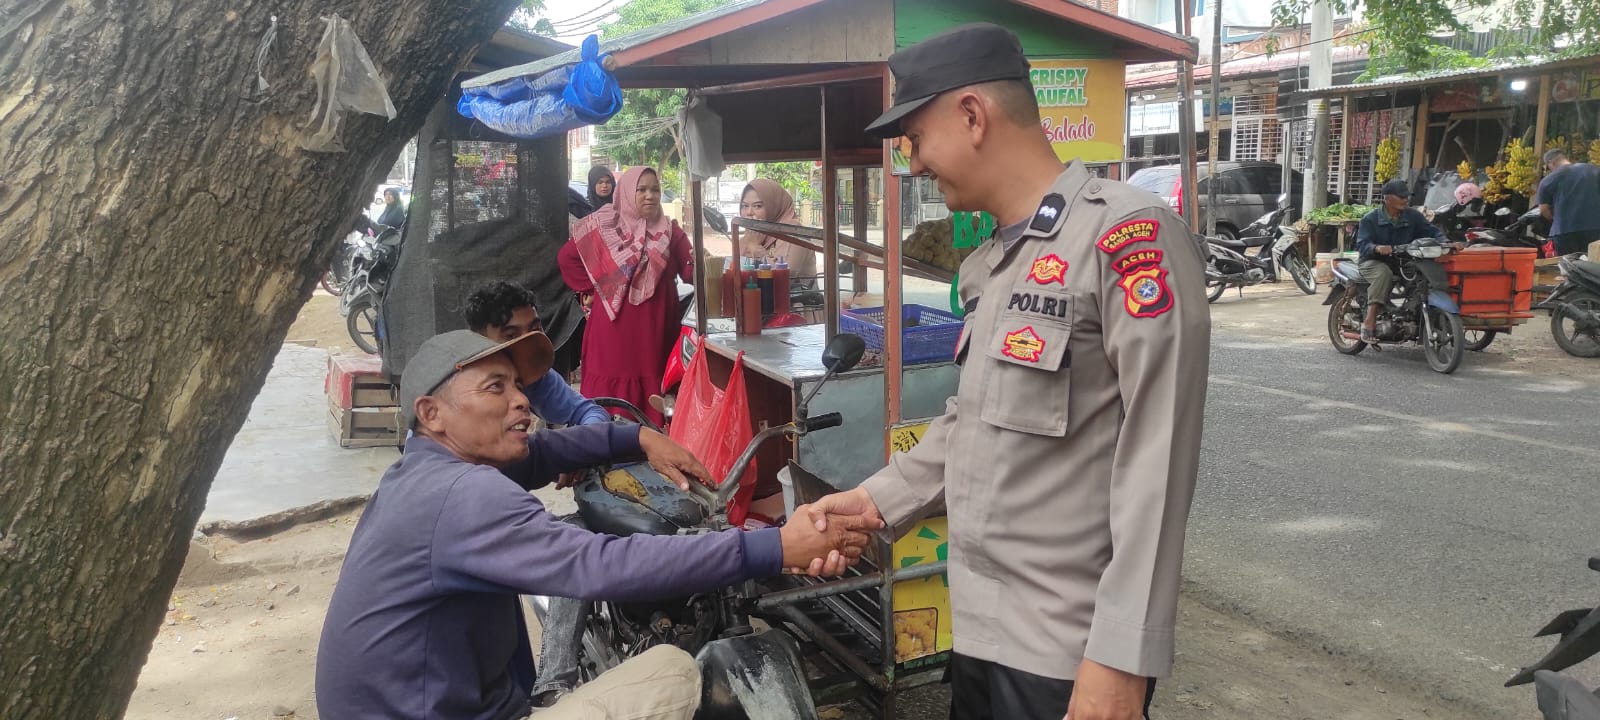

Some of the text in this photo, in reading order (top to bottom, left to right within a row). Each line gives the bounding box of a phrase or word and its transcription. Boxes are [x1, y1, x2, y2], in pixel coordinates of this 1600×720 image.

[1030, 68, 1087, 86] CRISPY
[1034, 88, 1087, 105] AUFAL
[1041, 115, 1095, 142] Balado
[1103, 223, 1153, 247] POLRESTA
[1122, 252, 1155, 268] ACEH
[1007, 293, 1068, 318] POLRI
